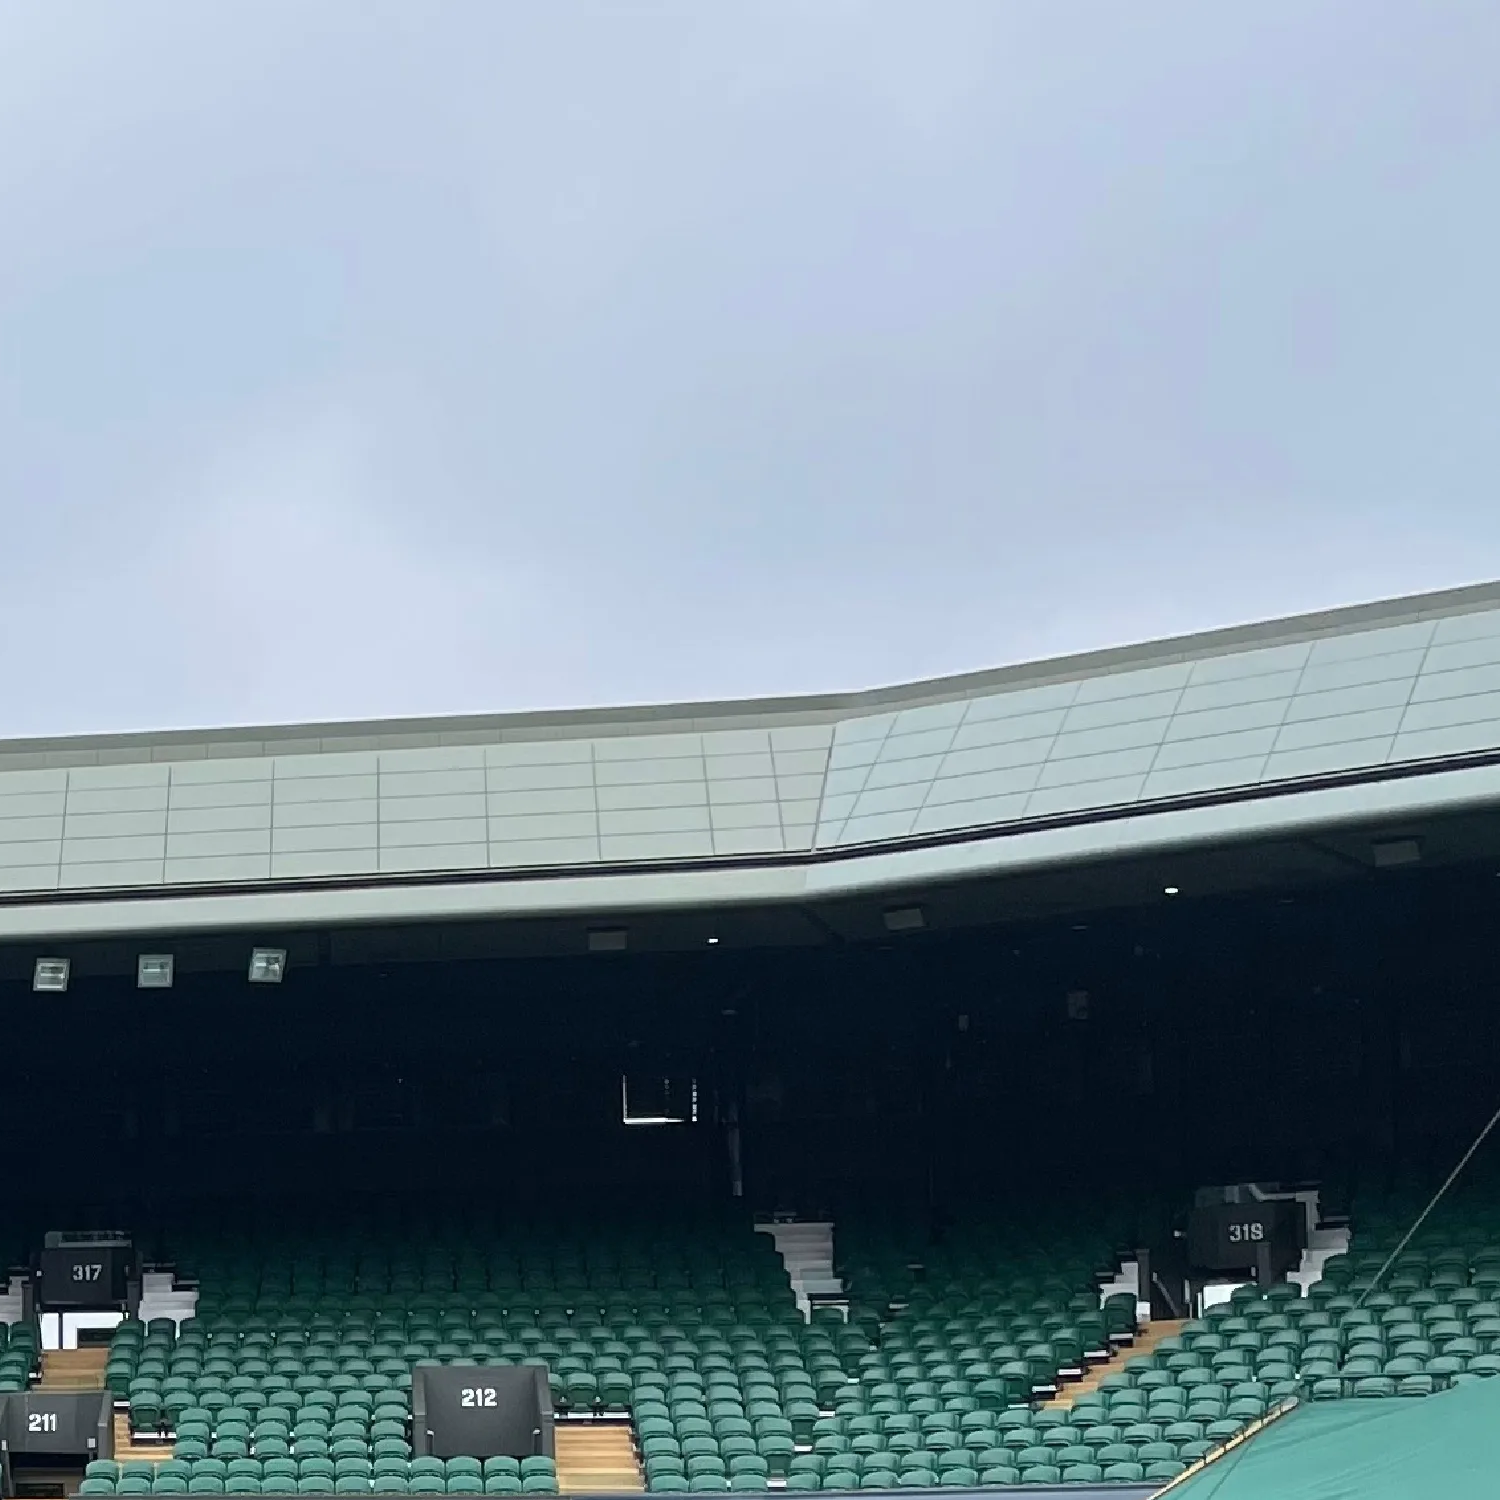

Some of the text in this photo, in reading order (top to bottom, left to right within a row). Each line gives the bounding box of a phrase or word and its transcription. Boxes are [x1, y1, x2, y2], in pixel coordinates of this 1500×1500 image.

[72, 1264, 102, 1281] 317
[461, 1388, 498, 1407] 212
[28, 1413, 57, 1432] 211
